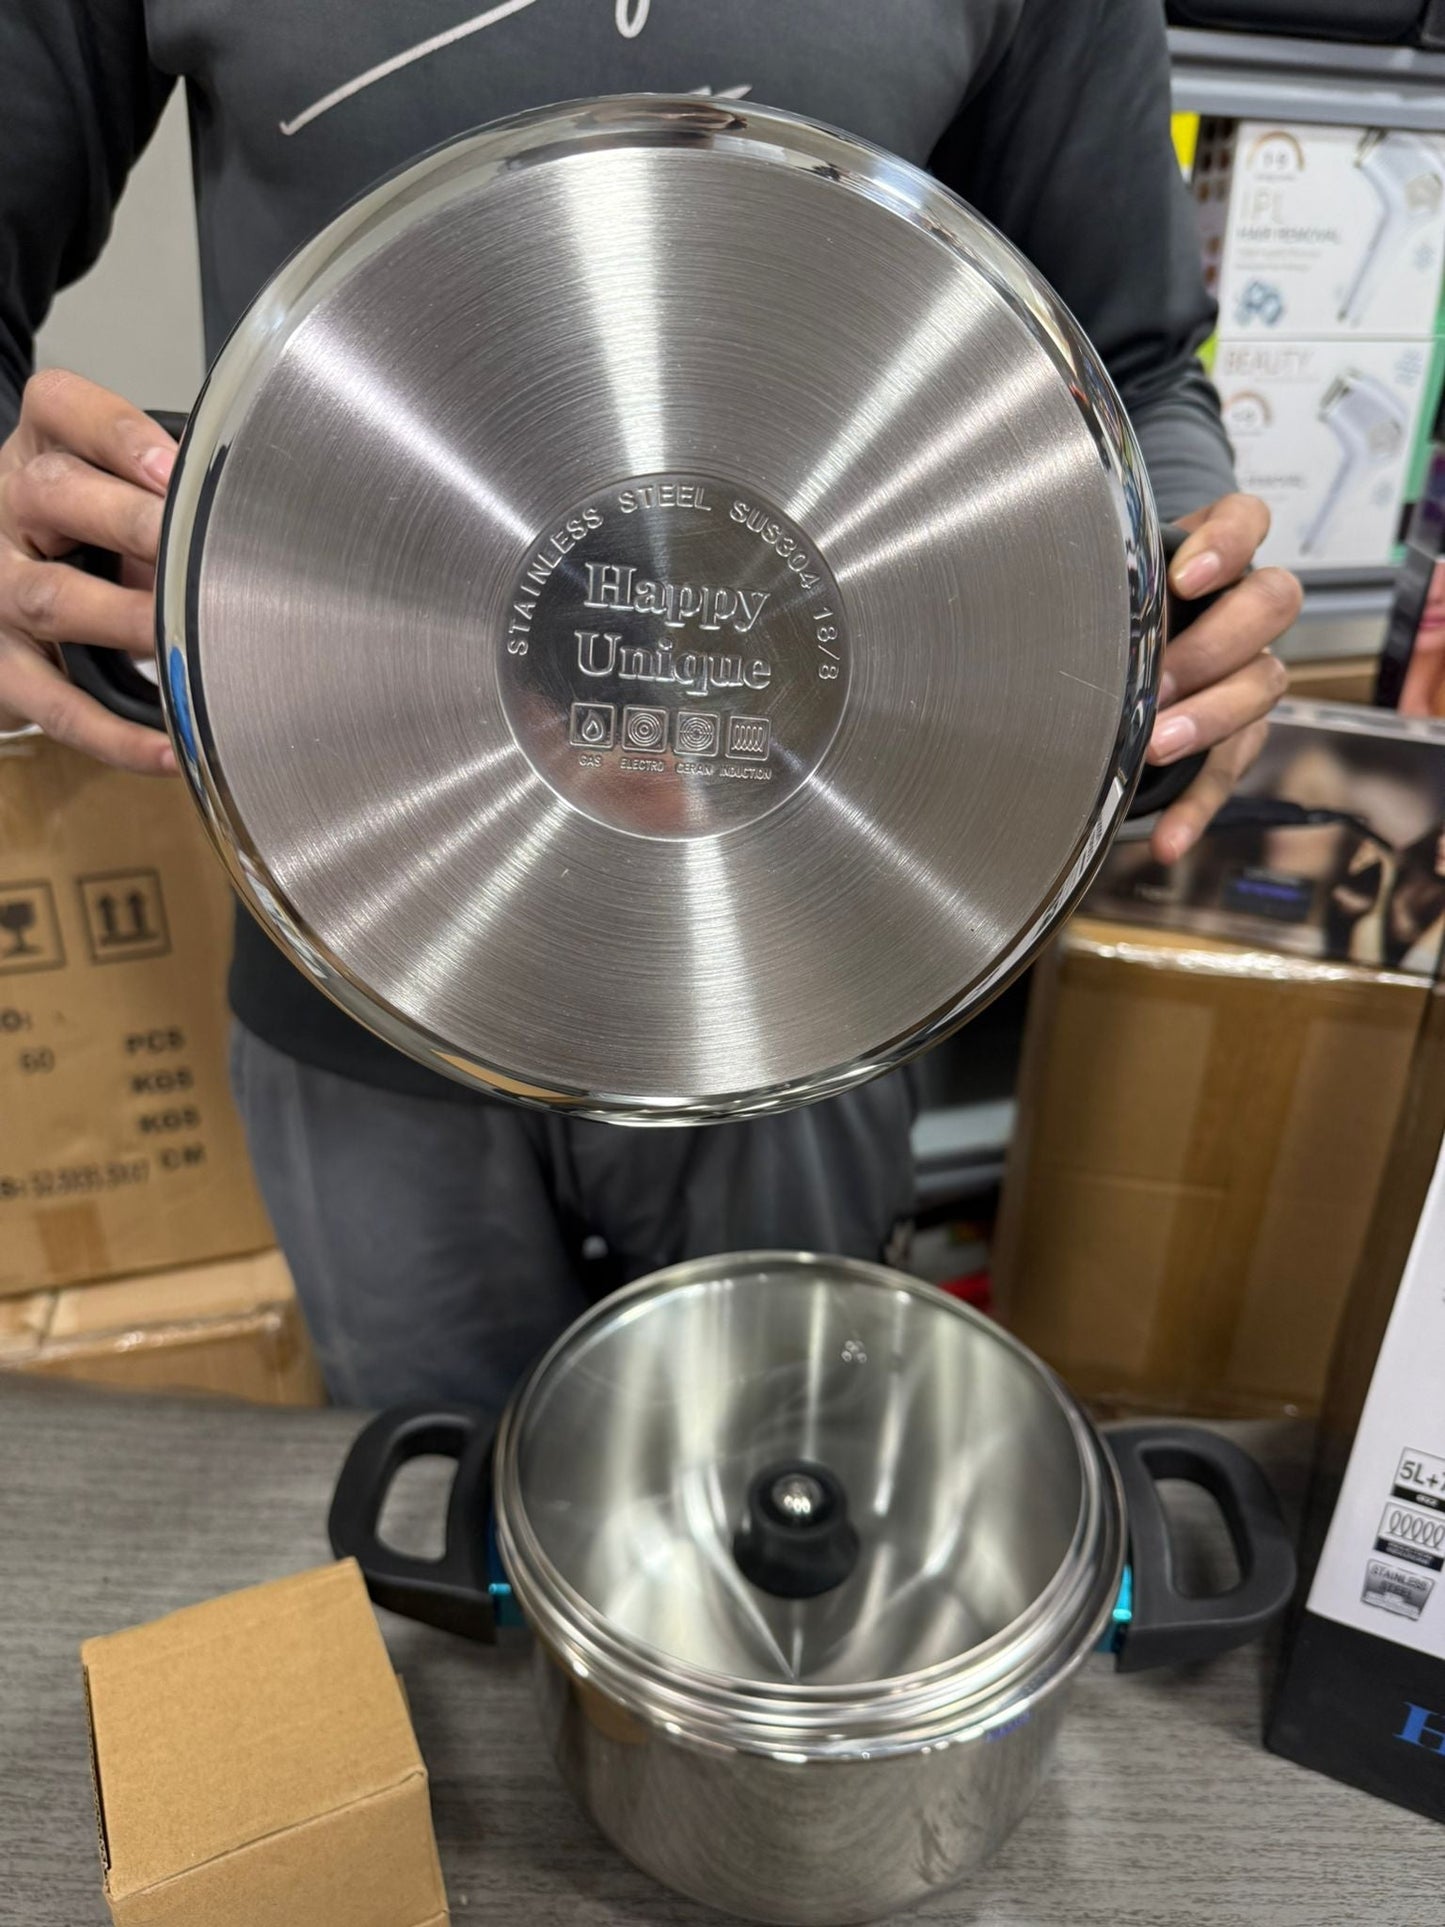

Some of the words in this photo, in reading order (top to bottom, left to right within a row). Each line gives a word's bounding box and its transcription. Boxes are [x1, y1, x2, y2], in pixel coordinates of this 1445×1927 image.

[507, 506, 604, 656] STAINLESS
[617, 484, 712, 513] STEEL
[729, 499, 821, 590] SUS304
[813, 606, 841, 680] 18/8
[584, 561, 771, 633] Happy
[574, 630, 772, 696] Unique
[579, 755, 602, 768] GAS
[620, 758, 665, 773] ELECTRO
[719, 765, 773, 780] INDUCTION
[124, 1025, 186, 1054] PCS
[130, 1066, 195, 1094] KGS
[138, 1105, 201, 1134] KGS
[1370, 1563, 1429, 1592] STAINLESS
